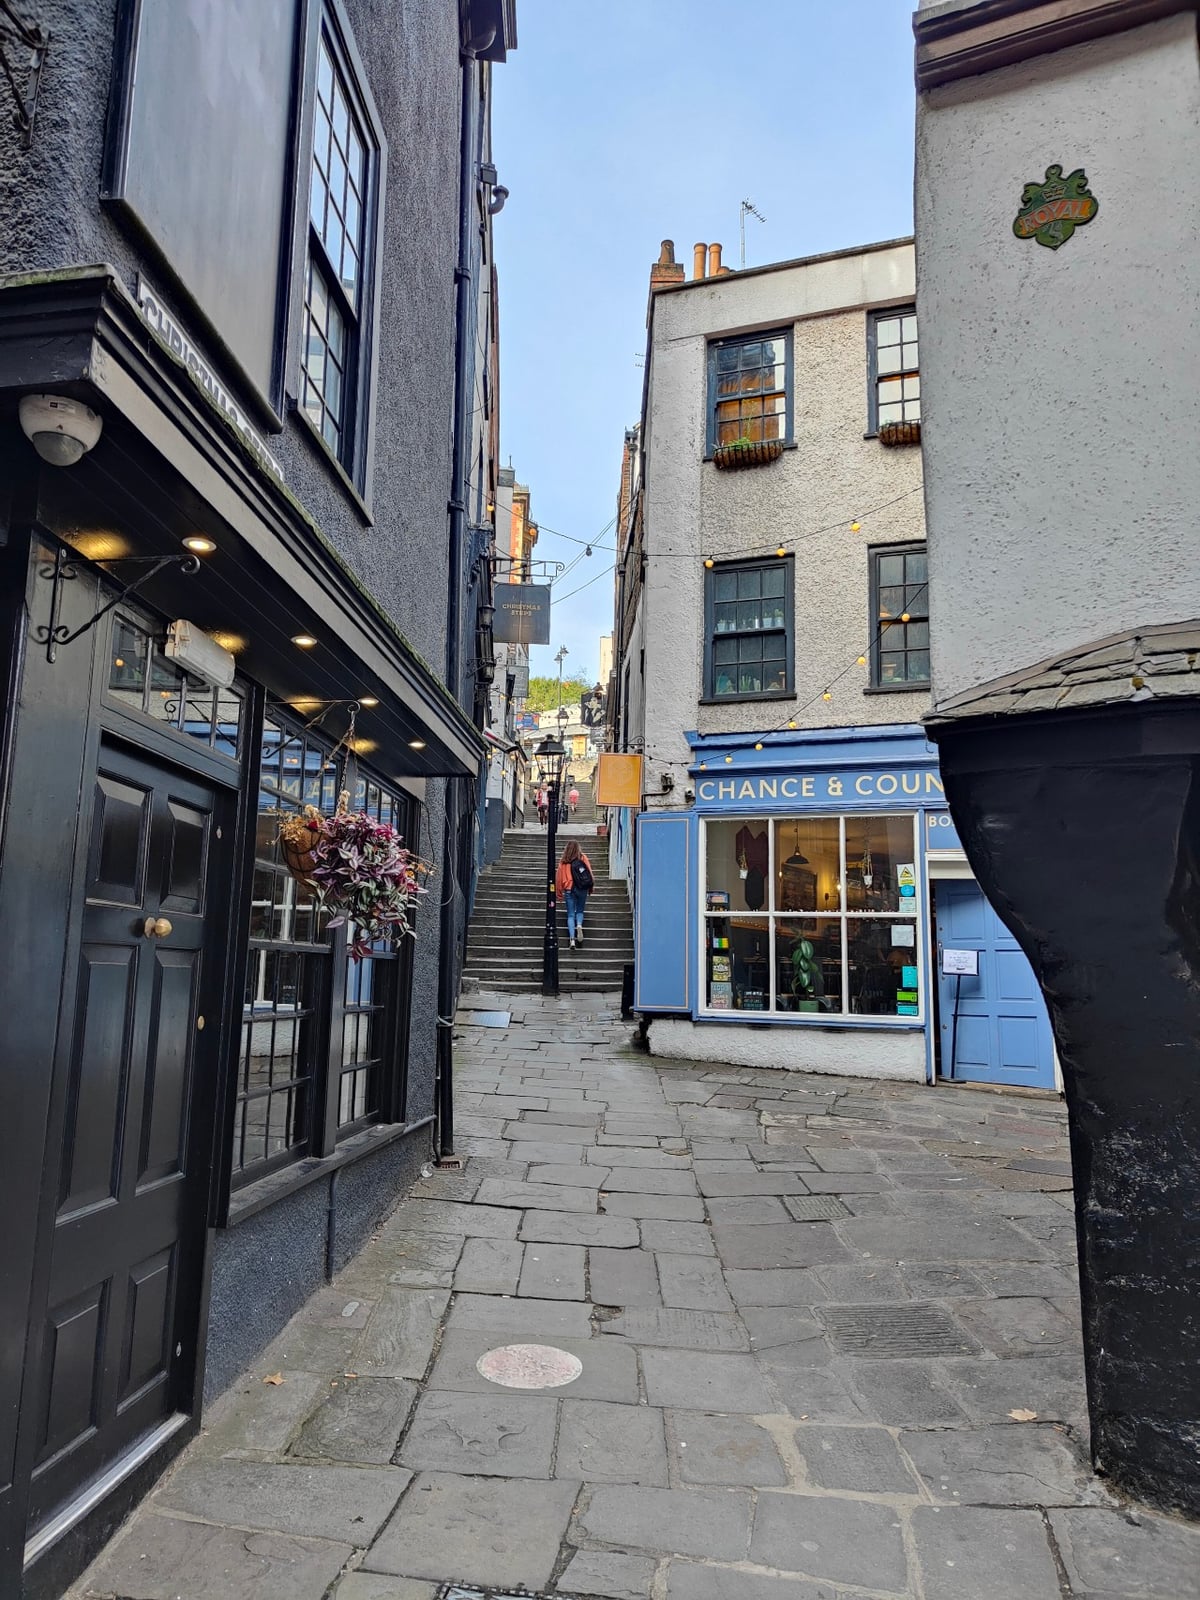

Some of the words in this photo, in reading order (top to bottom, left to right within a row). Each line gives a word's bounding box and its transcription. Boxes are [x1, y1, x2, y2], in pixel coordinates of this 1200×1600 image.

[1024, 199, 1087, 231] ROYAL
[502, 602, 542, 611] CHRISTMAS
[699, 777, 815, 800] CHANCE
[827, 776, 843, 796] &
[928, 815, 955, 828] BO
